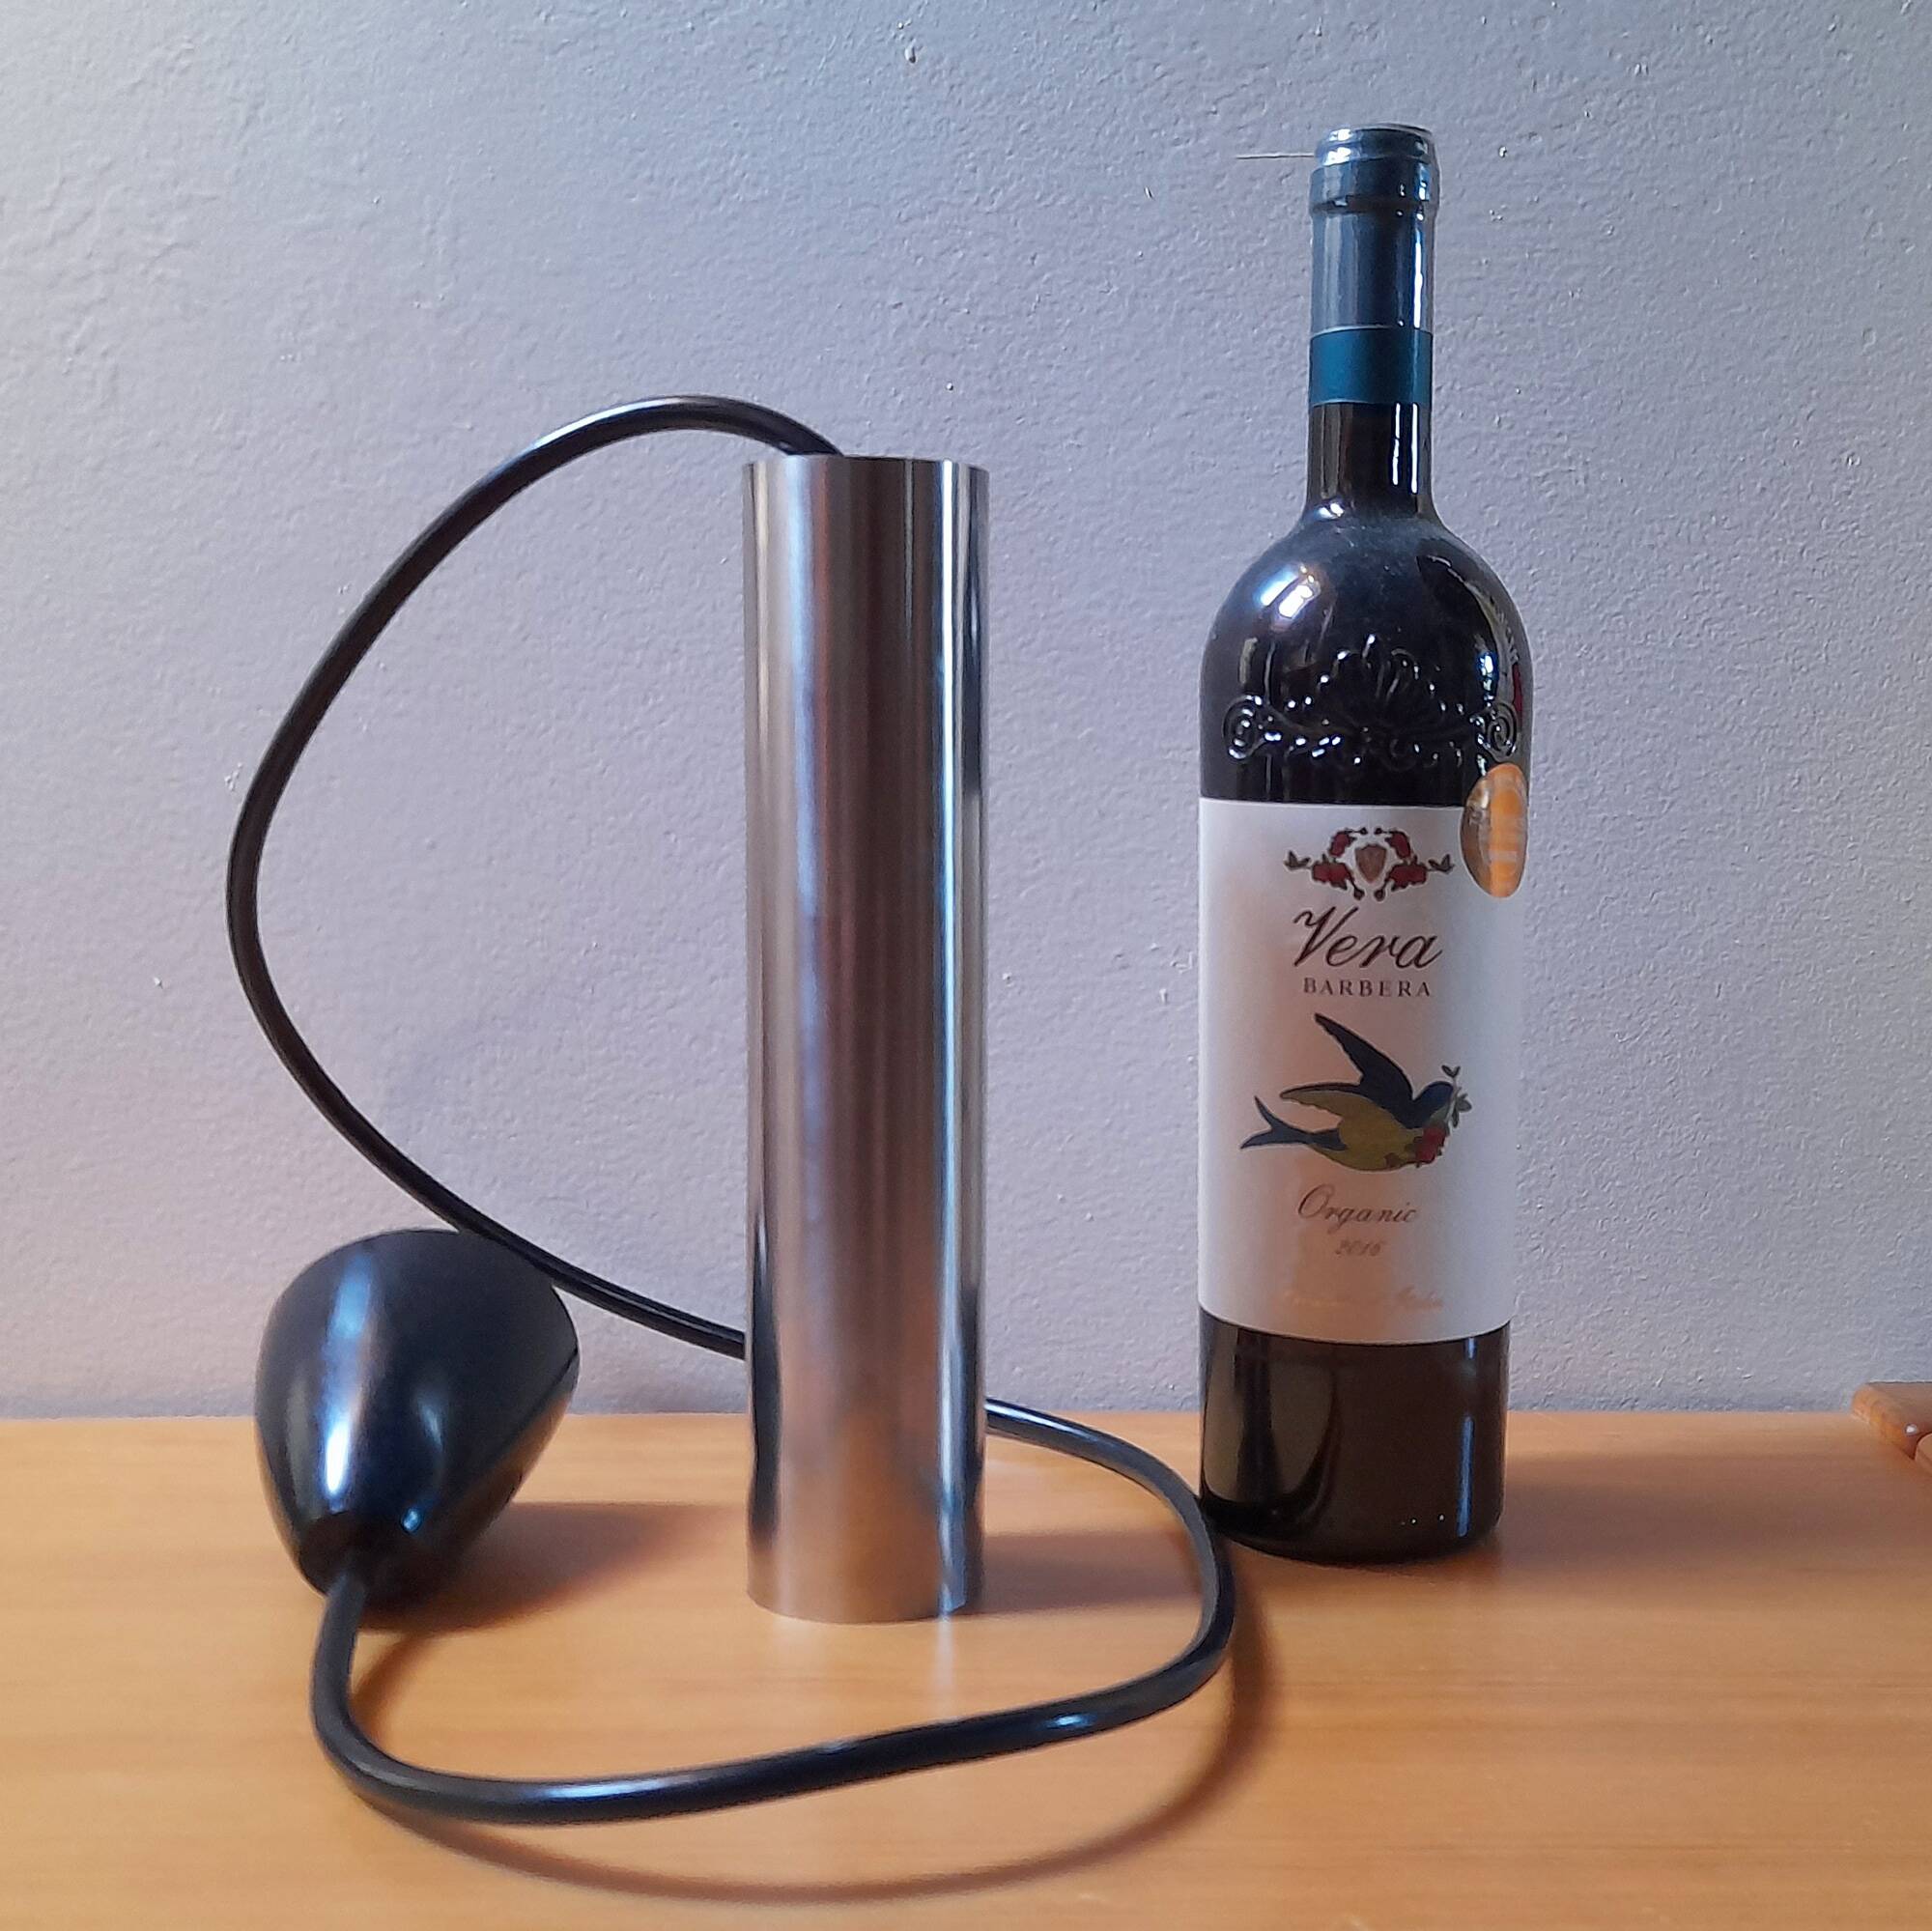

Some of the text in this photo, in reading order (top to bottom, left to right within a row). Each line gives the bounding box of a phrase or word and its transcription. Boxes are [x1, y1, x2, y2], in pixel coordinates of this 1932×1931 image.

[1293, 906, 1443, 969] Vera
[1304, 978, 1431, 997] BARBERA
[1297, 1183, 1417, 1235] Organic
